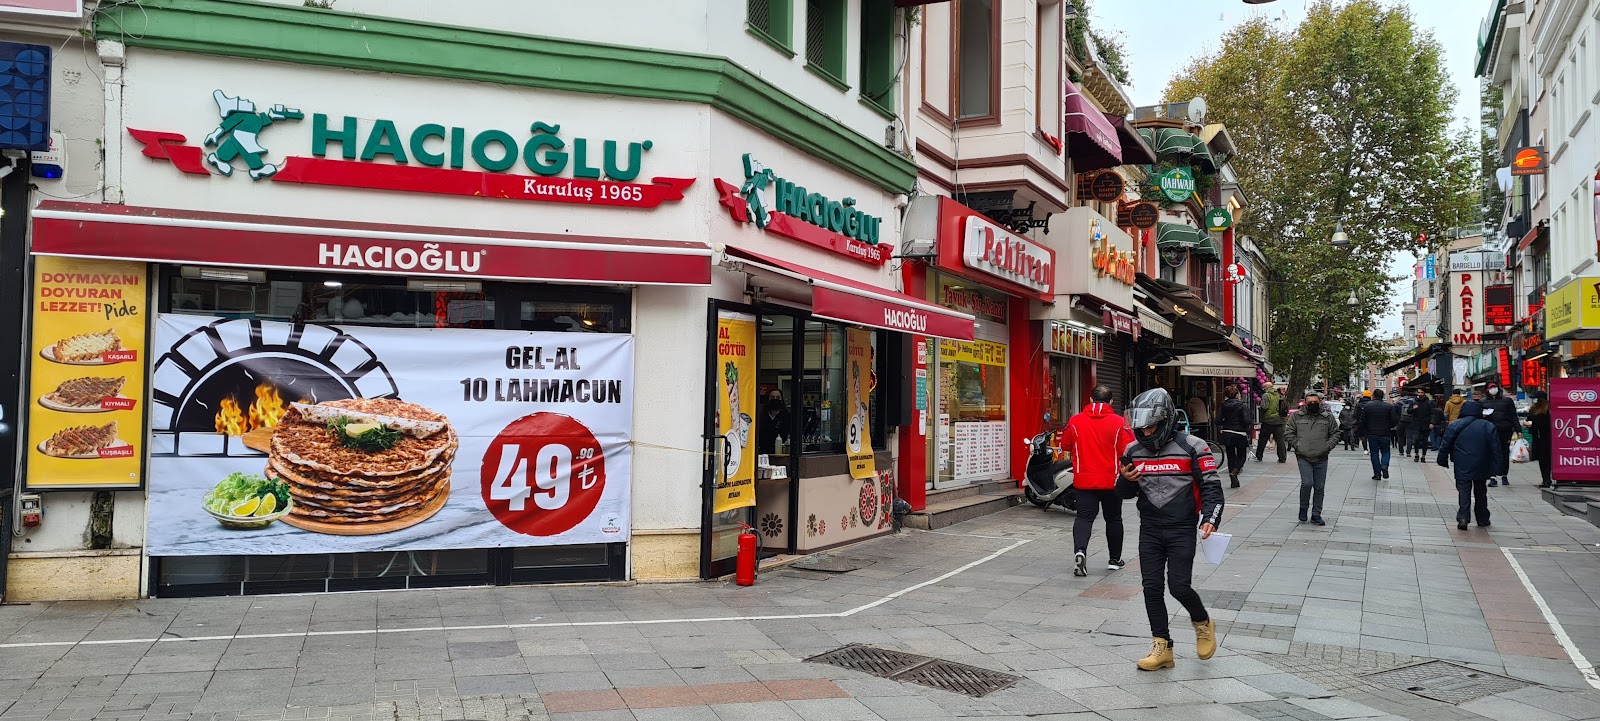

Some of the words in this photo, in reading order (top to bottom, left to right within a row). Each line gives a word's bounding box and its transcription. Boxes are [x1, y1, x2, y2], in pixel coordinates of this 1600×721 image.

[311, 112, 642, 181] HACIOĞLU
[523, 178, 594, 201] Kuruluş
[599, 184, 643, 202] 1965
[1161, 176, 1194, 190] QAHWAH
[774, 177, 882, 246] HACIOĞLU
[318, 242, 482, 274] HACIOĞLU
[846, 240, 867, 260] Kuruluş
[867, 247, 881, 261] 1965
[984, 225, 1050, 285] Pehlivan
[1452, 261, 1481, 269] BARGELLO
[41, 272, 139, 286] DOYMAYANI
[40, 286, 122, 299] DOYURAN
[943, 284, 968, 309] Tavuk
[985, 295, 1005, 319] Kanat
[40, 301, 102, 313] LEZZET!
[104, 299, 138, 320] Pide
[1459, 273, 1475, 344] PARFÜM
[884, 307, 927, 332] HACIOĞLU
[718, 326, 730, 340] AL
[107, 353, 134, 361] KAŞARLI
[505, 345, 581, 370] GEL-AL
[718, 342, 746, 357] GÖTÜR
[848, 344, 864, 357] GÖTÜR
[460, 377, 488, 402] 10
[494, 378, 622, 404] LAHMACUN
[1569, 390, 1596, 401] eve
[850, 423, 857, 445] 9
[490, 443, 573, 511] 49
[1144, 463, 1181, 472] HONDA
